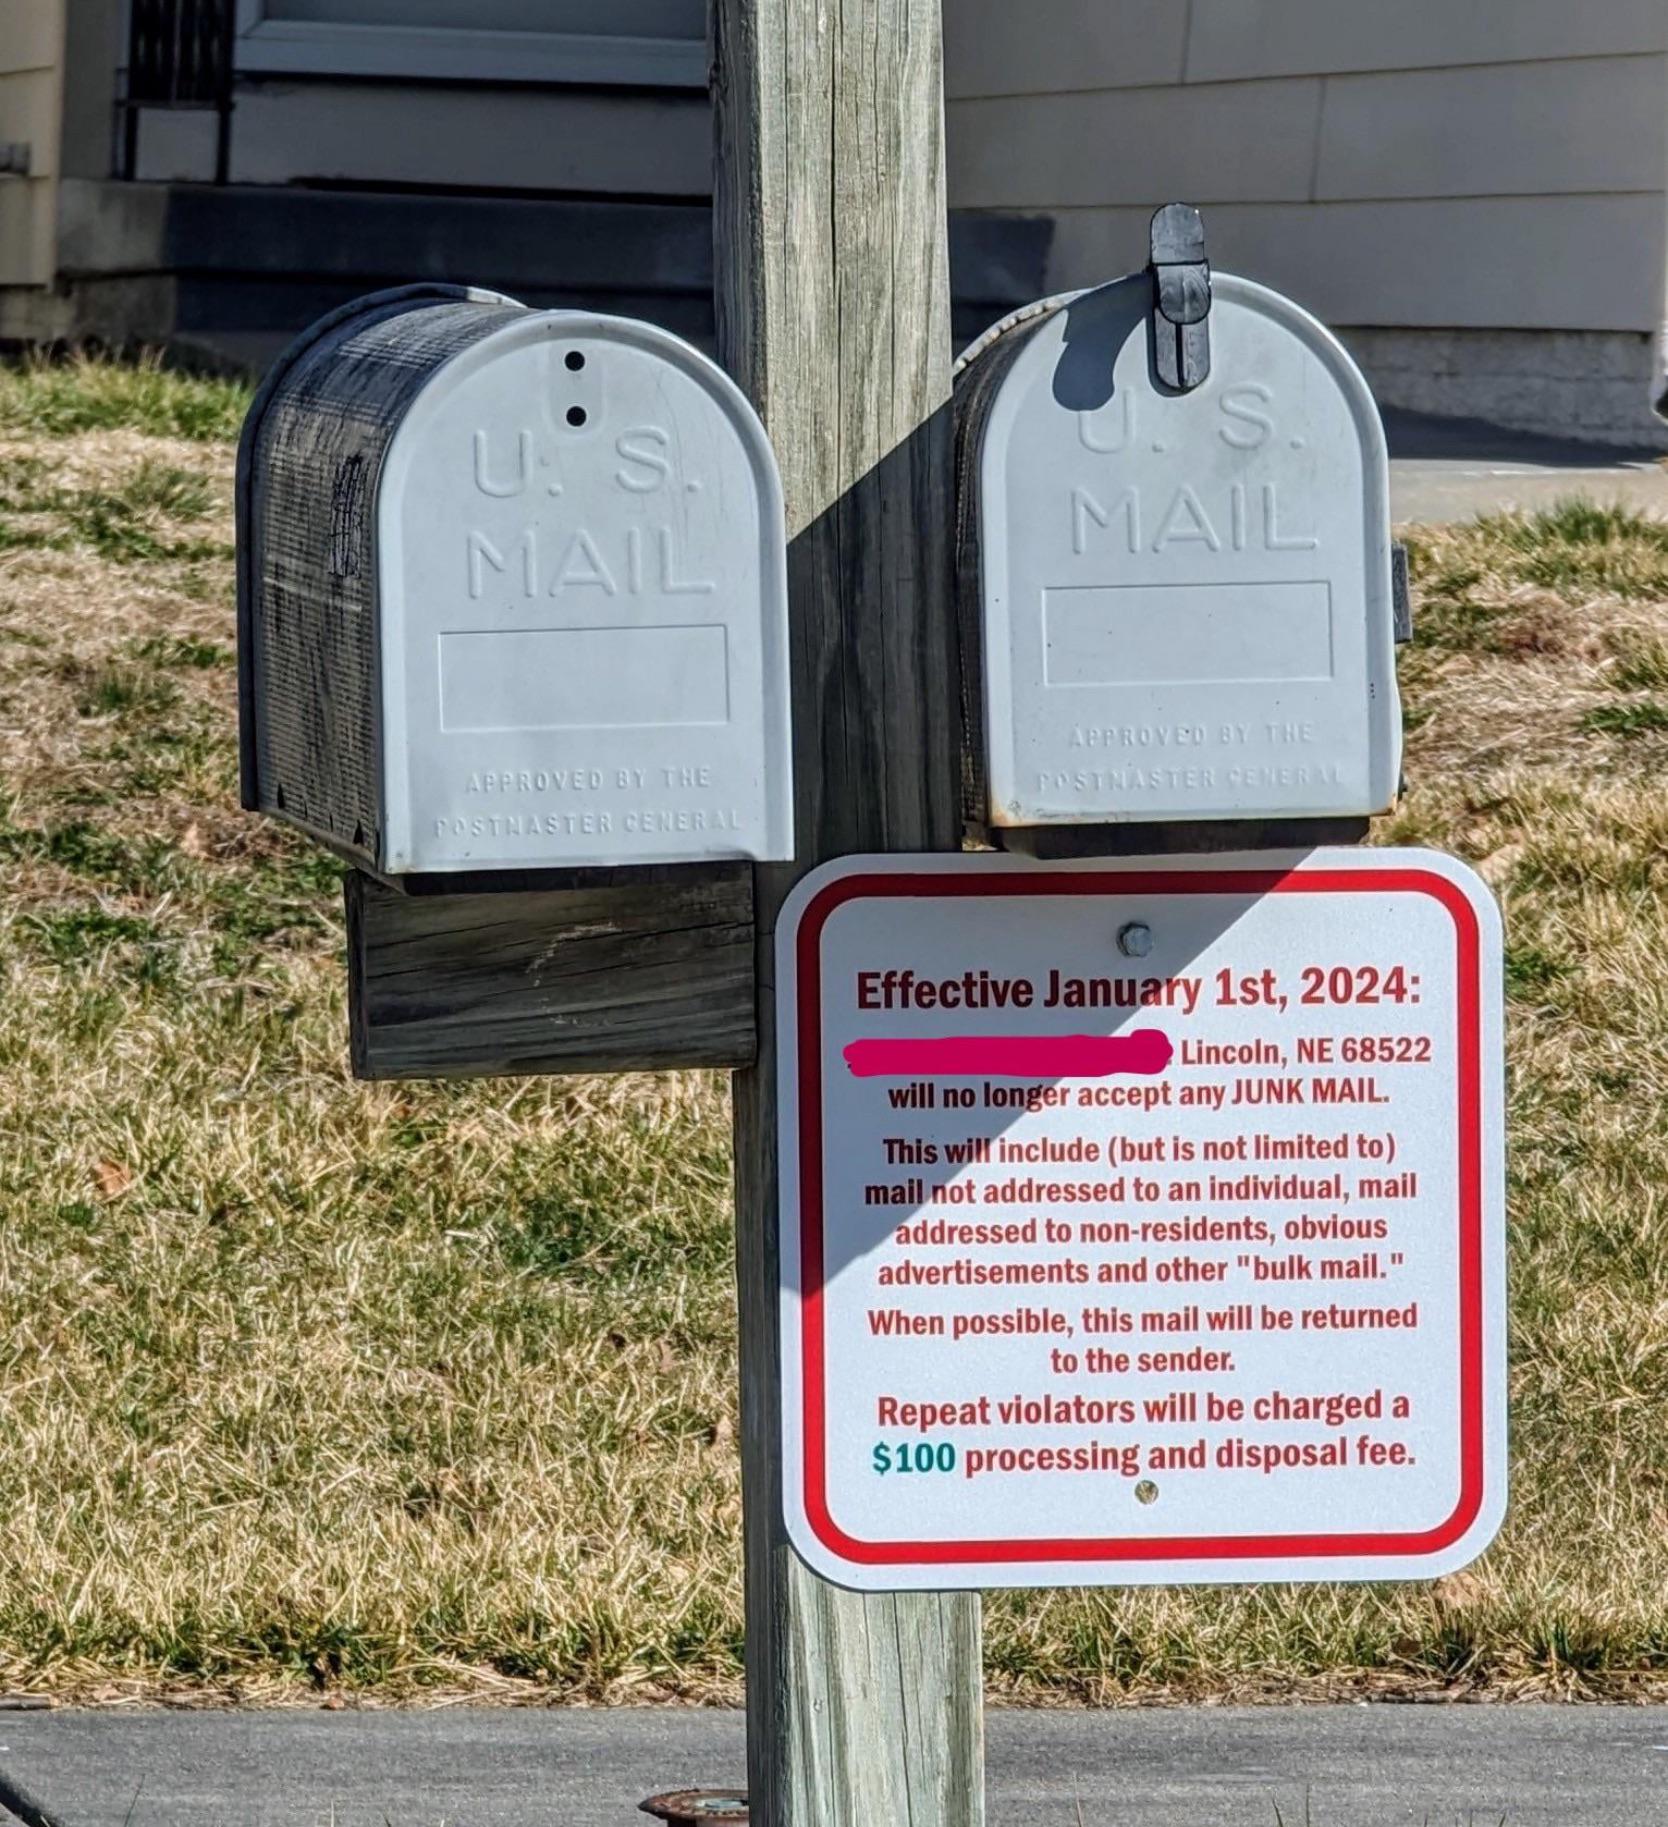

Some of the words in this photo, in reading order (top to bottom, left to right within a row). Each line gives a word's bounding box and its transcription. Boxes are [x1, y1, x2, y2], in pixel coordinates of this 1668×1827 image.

[1071, 483, 1319, 554] MAIL
[467, 525, 716, 600] MAIL
[1070, 724, 1208, 750] APPROVED
[1219, 722, 1251, 746] BY
[1265, 720, 1316, 744] THE
[465, 767, 605, 793] APPROVED
[615, 768, 647, 789] BY
[662, 764, 713, 789] THE
[1036, 767, 1218, 793] POSTMASTER
[1227, 760, 1346, 788] GENERAL
[433, 811, 614, 839] POSTMASTER
[623, 807, 744, 834] GENERAL
[857, 970, 1034, 1010] Effective
[1043, 969, 1203, 1015] January
[1215, 967, 1289, 1012] 1st,
[1300, 965, 1422, 1006] 2024:
[1180, 1038, 1289, 1069] Lincoln,
[1296, 1038, 1335, 1065] NE
[1340, 1037, 1432, 1065] 68522
[887, 1082, 935, 1110] will
[941, 1088, 976, 1109] no
[983, 1082, 1071, 1113] longer
[1076, 1082, 1172, 1112] accept
[1179, 1085, 1226, 1110] any
[1231, 1078, 1305, 1105] JUNK
[1310, 1078, 1390, 1104] MAIL.
[882, 1138, 939, 1166] This
[943, 1137, 990, 1166] will
[998, 1136, 1100, 1165] include
[1107, 1135, 1166, 1167] (but
[1171, 1136, 1195, 1162] is
[1202, 1137, 1247, 1162] not
[1253, 1134, 1349, 1161] limited
[1355, 1133, 1397, 1164] to)
[863, 1179, 924, 1207] mail
[931, 1180, 977, 1205] not
[983, 1176, 1125, 1204] addressed
[1132, 1177, 1160, 1202] to
[1167, 1181, 1202, 1202] an
[1208, 1174, 1351, 1205] individual,
[1357, 1172, 1417, 1200] mail
[894, 1218, 1038, 1246] addressed
[1044, 1220, 1072, 1244] to
[1078, 1216, 1277, 1246] non-residents,
[1283, 1213, 1388, 1240] obvious
[877, 1258, 1091, 1287] advertisements
[1096, 1257, 1149, 1285] and
[1154, 1256, 1229, 1283] other
[1237, 1254, 1314, 1283] "bulk
[1319, 1252, 1404, 1280] mail."
[867, 1309, 946, 1337] When
[952, 1308, 1075, 1342] possible,
[1081, 1306, 1134, 1334] this
[1140, 1305, 1200, 1333] mail
[1205, 1304, 1254, 1331] will
[1260, 1304, 1294, 1331] be
[1300, 1301, 1418, 1330] returned
[1050, 1349, 1079, 1374] to
[1084, 1348, 1130, 1373] the
[1137, 1346, 1236, 1373] sender.
[877, 1395, 991, 1434] Repeat
[997, 1394, 1136, 1425] violators
[1142, 1391, 1198, 1423] will
[1206, 1391, 1245, 1422] be
[1253, 1388, 1383, 1426] charged
[1390, 1394, 1410, 1419] a
[871, 1441, 957, 1476] $100
[964, 1439, 1140, 1478] processing
[1147, 1438, 1207, 1471] and
[1214, 1436, 1349, 1474] disposal
[1355, 1434, 1416, 1466] fee.
